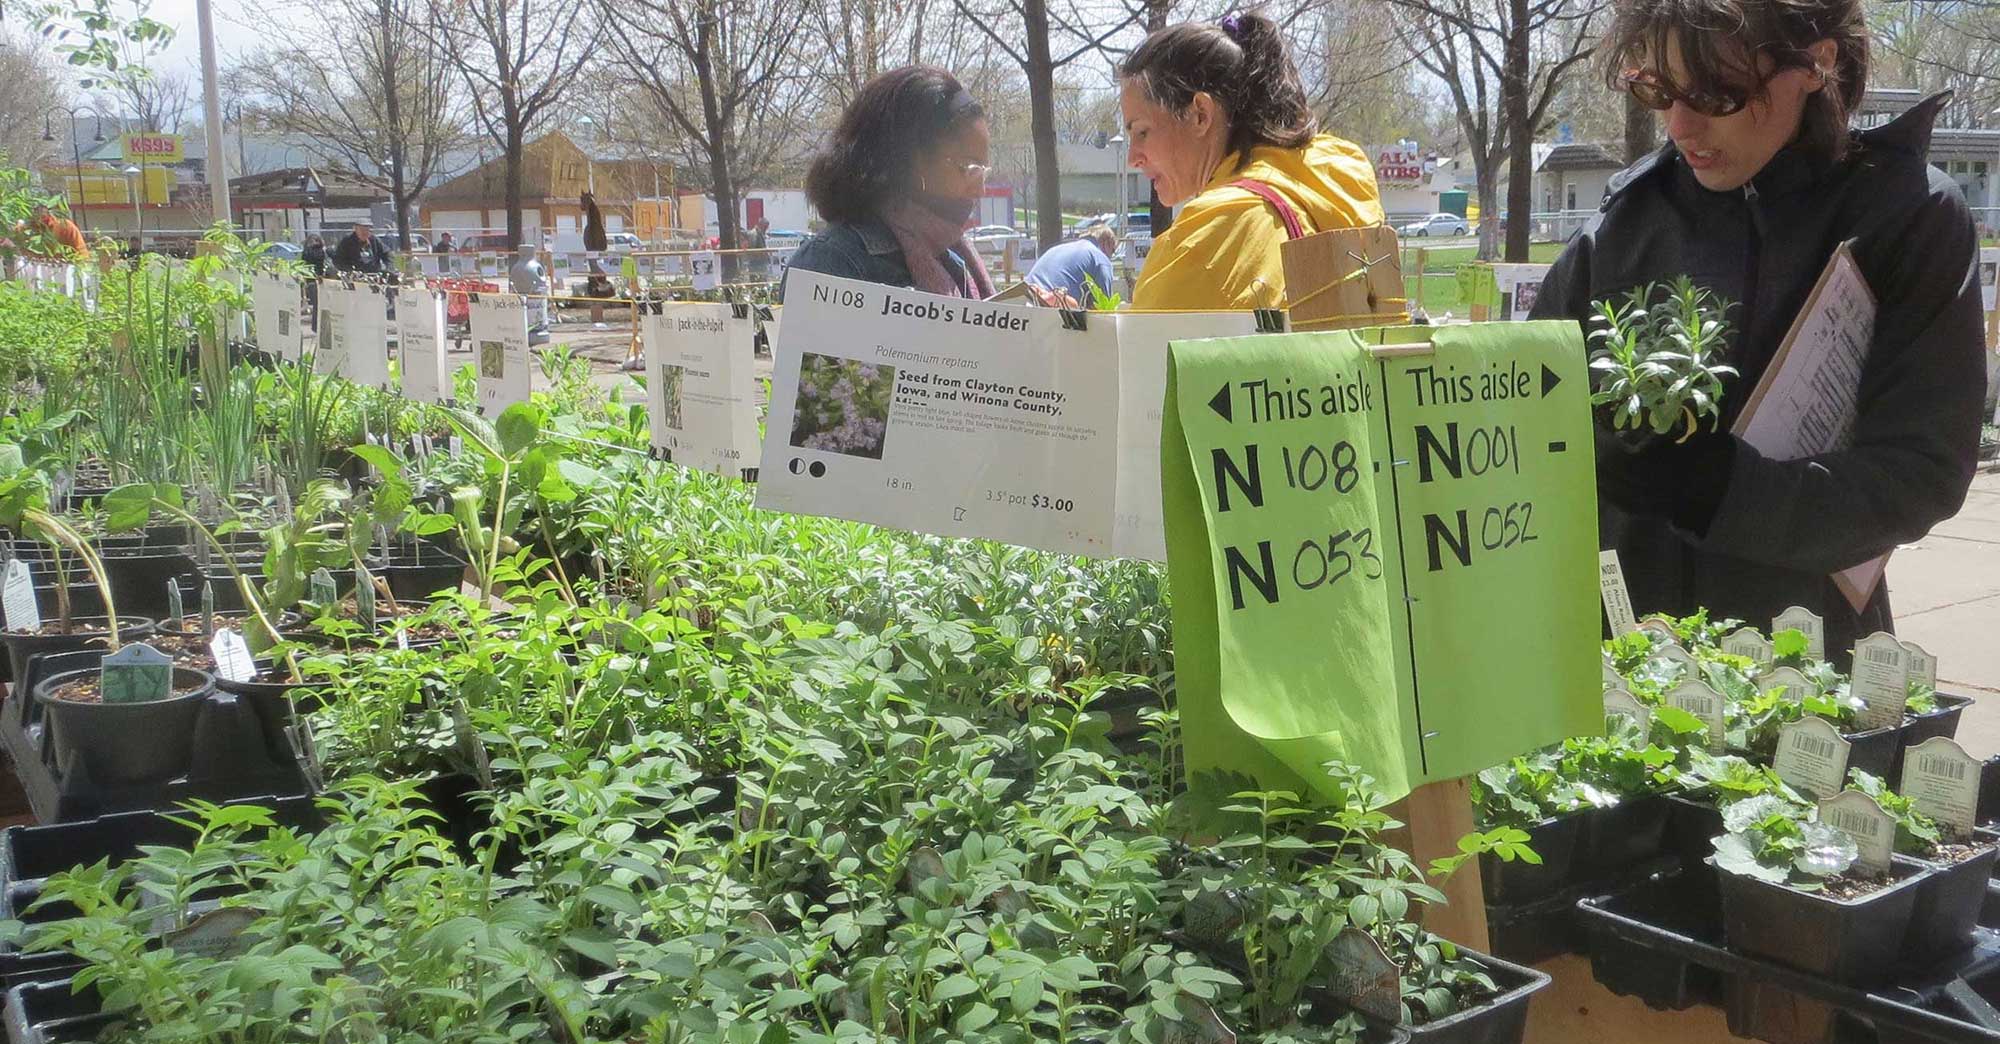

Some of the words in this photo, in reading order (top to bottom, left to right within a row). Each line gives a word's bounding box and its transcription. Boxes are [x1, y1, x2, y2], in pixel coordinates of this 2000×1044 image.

[813, 284, 865, 309] N108
[881, 294, 954, 322] Jacob's
[961, 306, 1029, 331] Ladder
[875, 345, 939, 366] Polemonium
[898, 370, 929, 384] Seed
[932, 374, 961, 388] from
[965, 379, 1014, 396] Clayton
[1018, 386, 1066, 403] County,
[1240, 377, 1313, 423] This
[1320, 369, 1373, 416] aisle
[1405, 365, 1474, 406] This
[1480, 359, 1531, 401] aisle
[896, 384, 930, 399] Iowa,
[934, 391, 957, 402] and
[961, 391, 1009, 408] Winona
[1013, 397, 1062, 416] County,
[886, 477, 899, 489] 18
[1009, 494, 1027, 506] pot
[1031, 493, 1074, 513] $3.00
